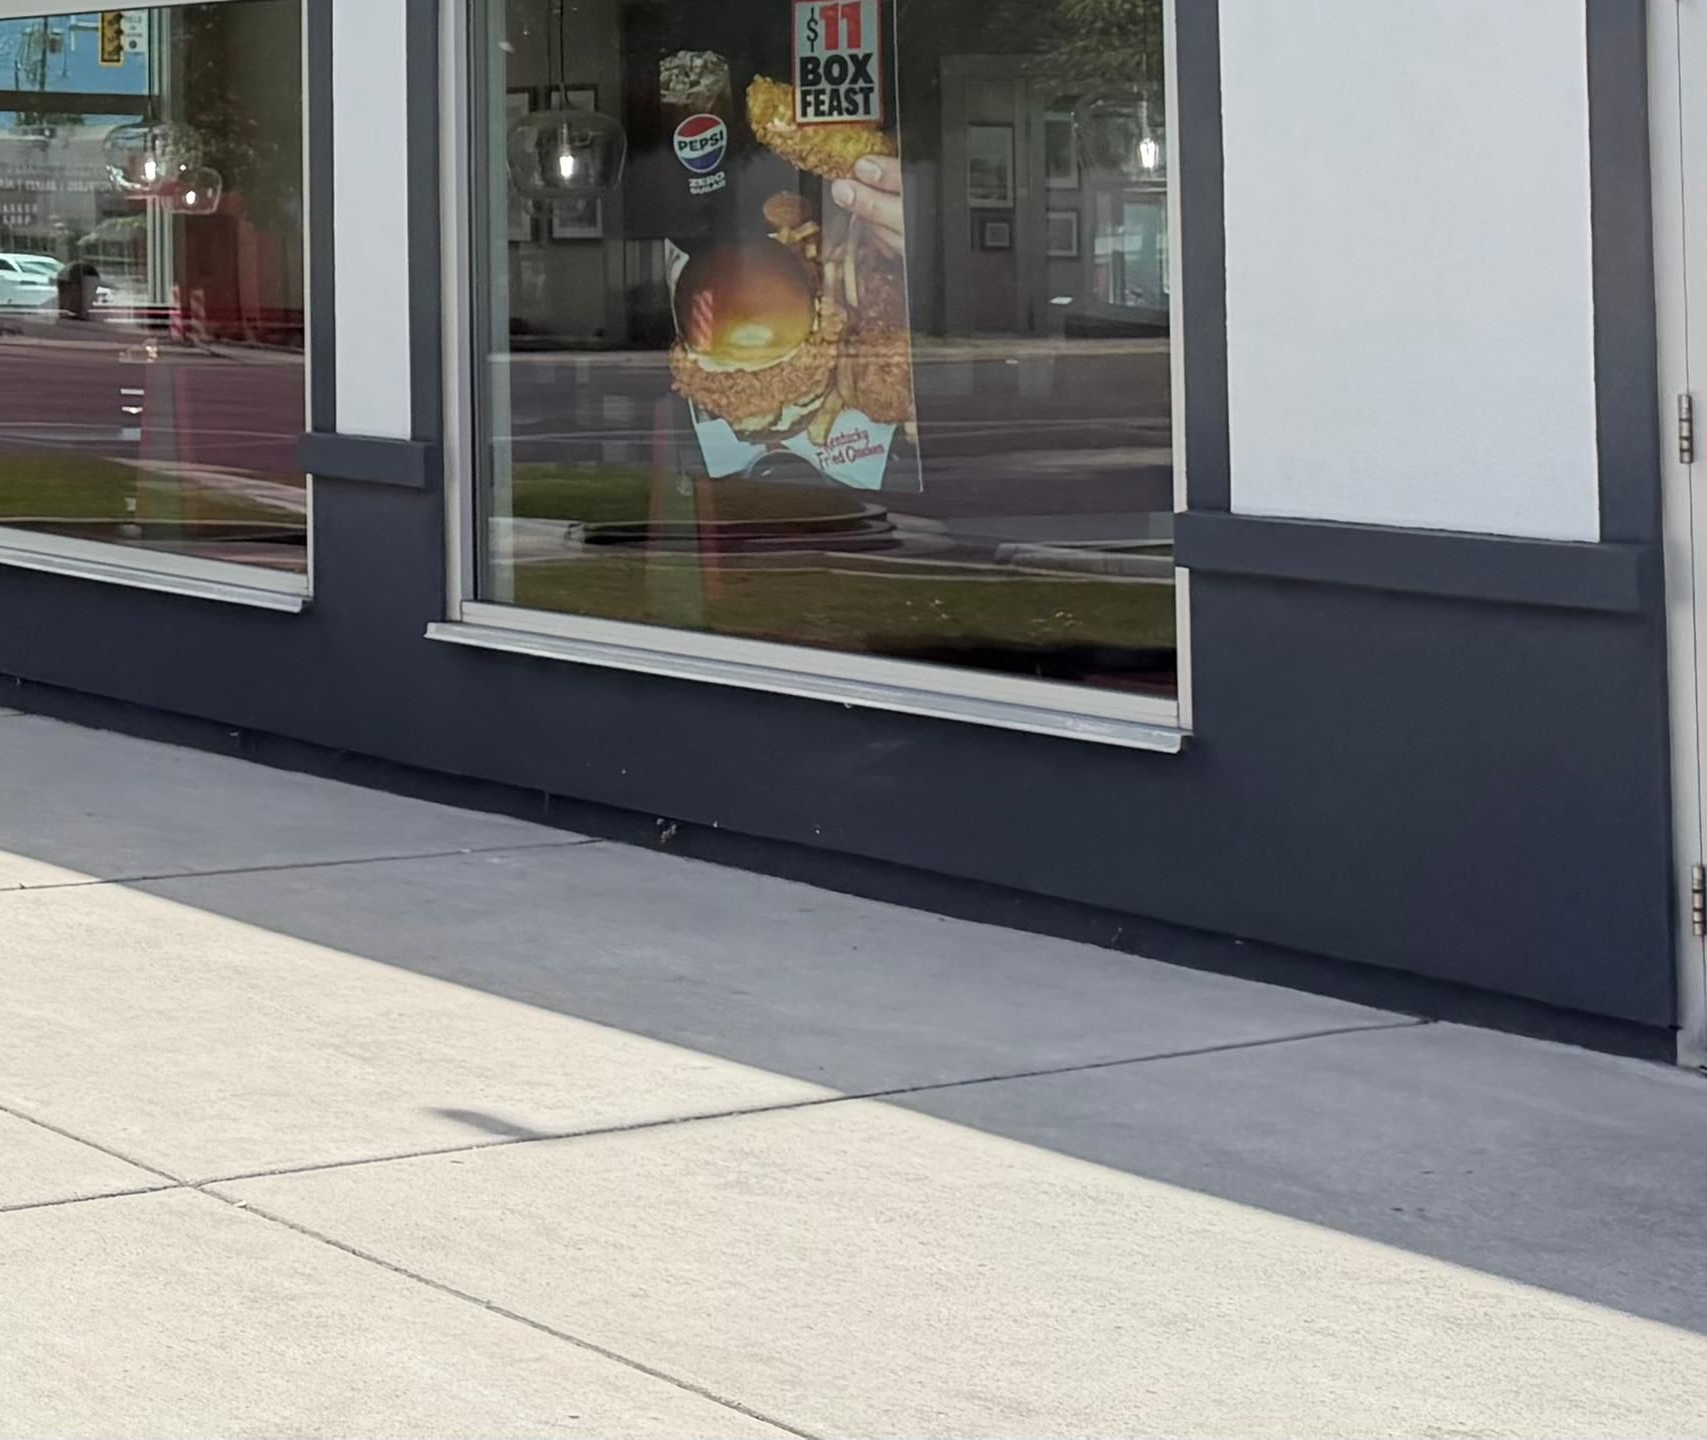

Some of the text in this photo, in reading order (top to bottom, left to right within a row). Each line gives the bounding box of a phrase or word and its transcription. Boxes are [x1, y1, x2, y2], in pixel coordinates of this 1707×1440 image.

[806, 2, 862, 53] $11
[799, 53, 875, 87] BOX
[800, 86, 875, 117] FEAST
[678, 129, 724, 152] PEPSI
